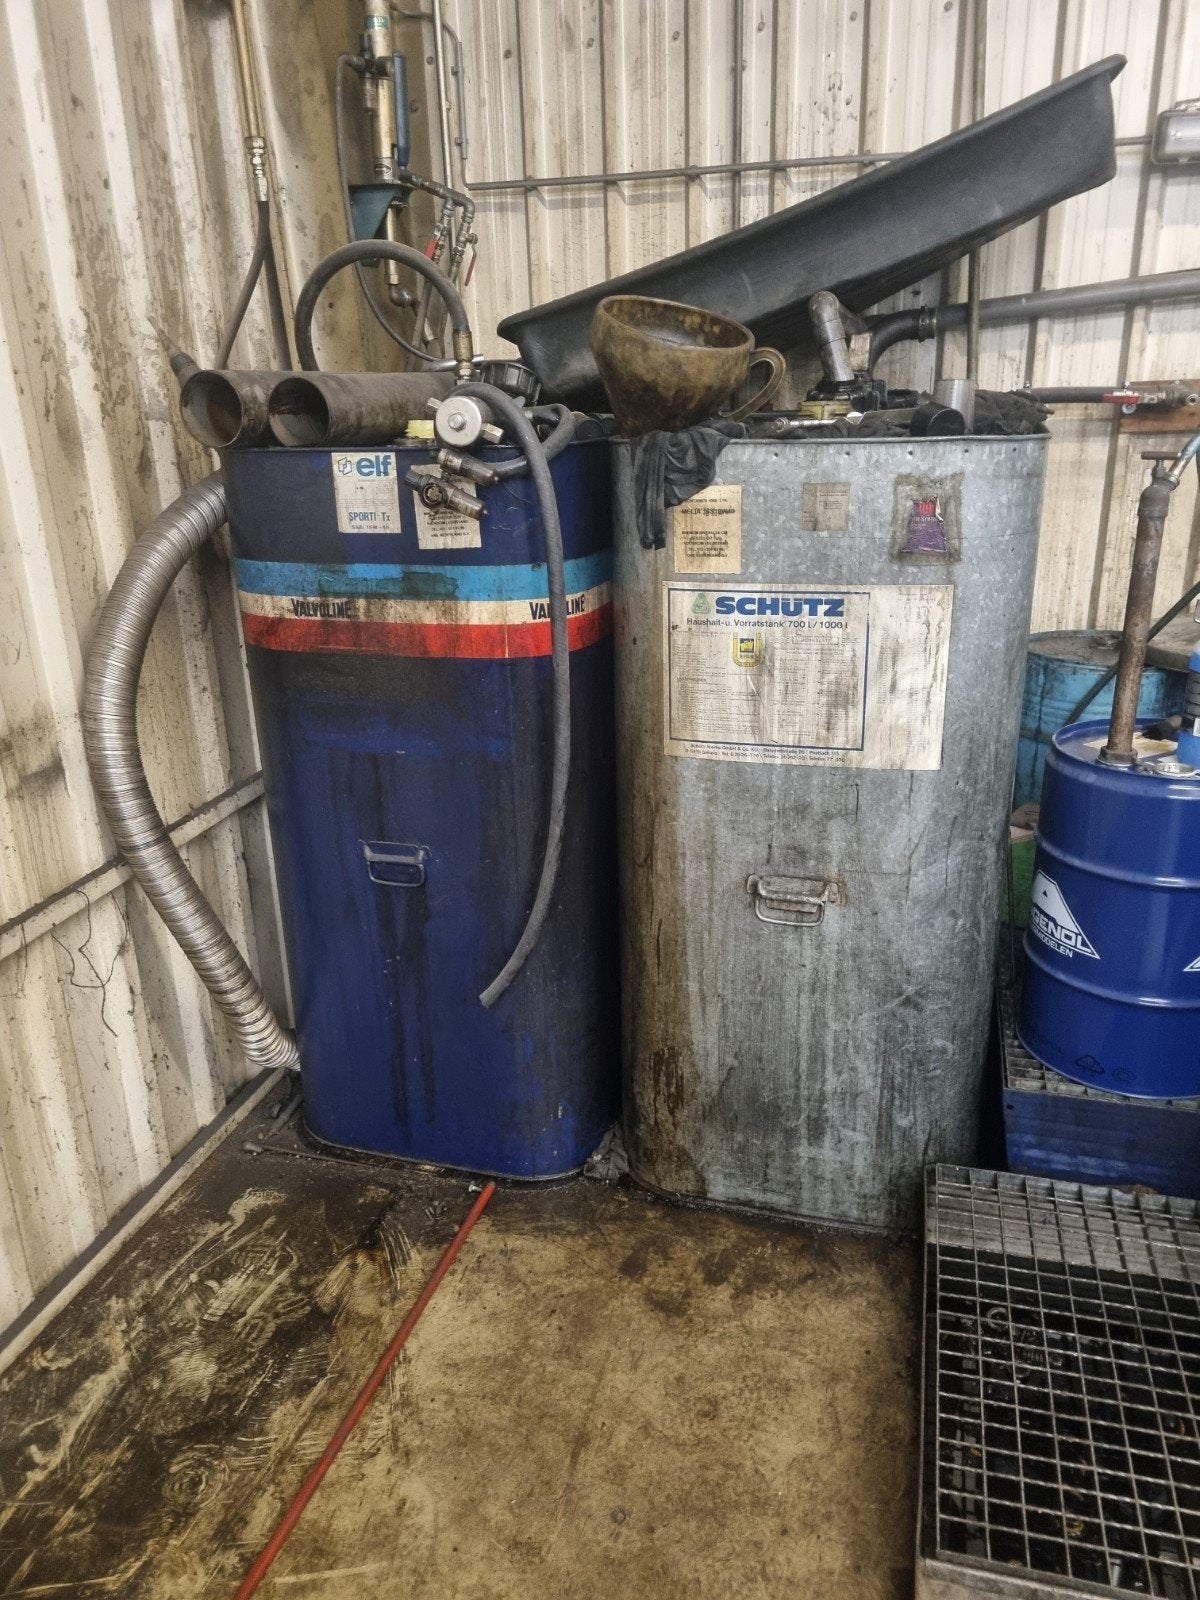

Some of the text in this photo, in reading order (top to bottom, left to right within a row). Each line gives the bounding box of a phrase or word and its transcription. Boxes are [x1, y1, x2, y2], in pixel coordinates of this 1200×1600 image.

[356, 455, 391, 476] elf
[291, 598, 352, 618] VALVOLINE
[529, 594, 586, 620] VALINE
[715, 596, 845, 617] SCHÜTZ
[734, 619, 784, 629] Vorratstank
[788, 620, 806, 629] 700
[820, 621, 843, 629] 1000
